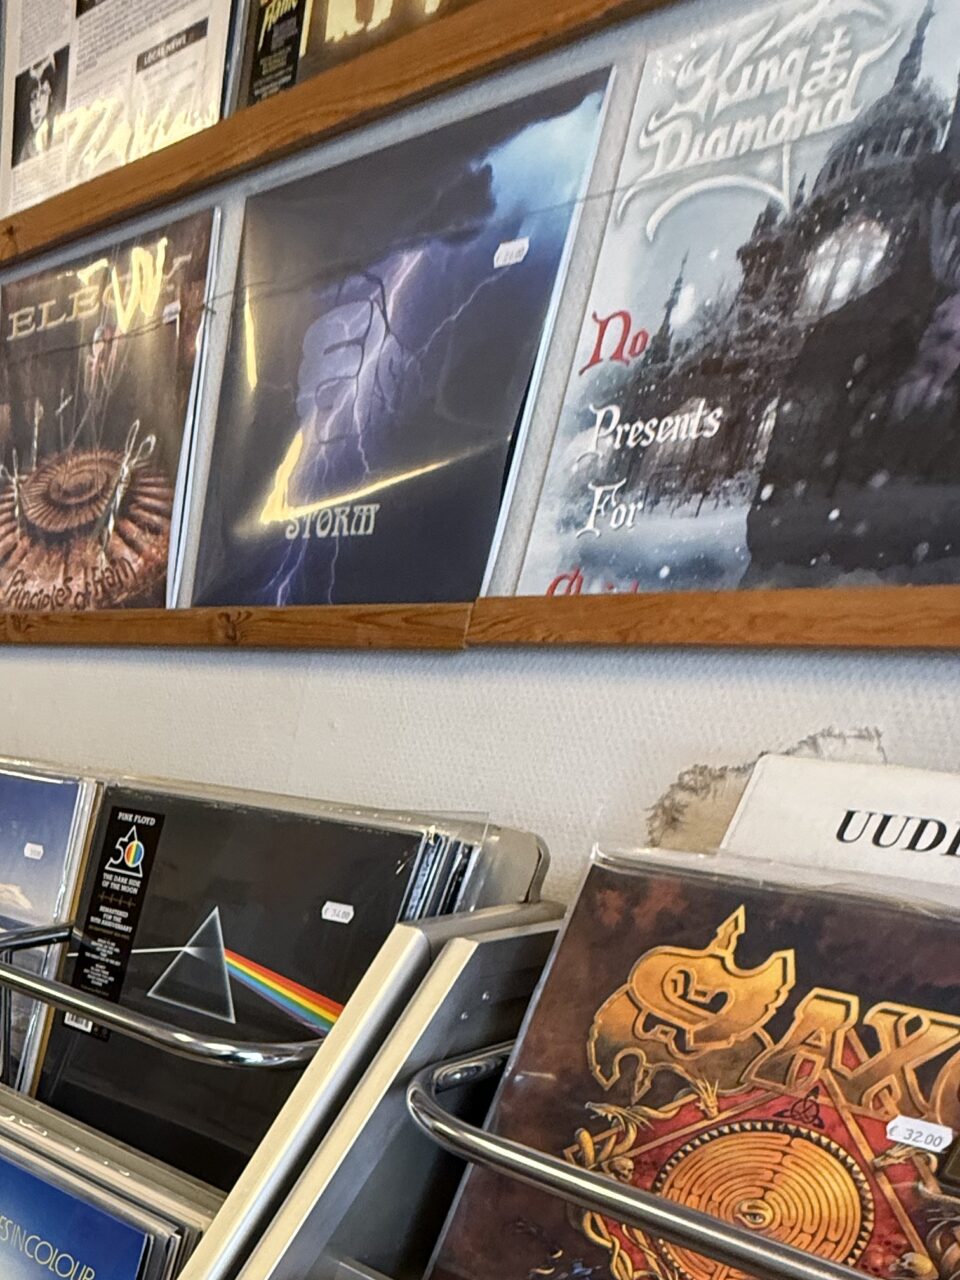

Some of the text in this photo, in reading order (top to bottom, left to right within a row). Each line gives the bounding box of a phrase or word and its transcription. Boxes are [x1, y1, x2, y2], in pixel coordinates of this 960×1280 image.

[645, 14, 812, 126] King
[638, 28, 900, 178] Diamond
[579, 311, 649, 375] No
[571, 397, 724, 472] Presents
[286, 503, 380, 539] STORM
[576, 477, 645, 540] For
[117, 811, 156, 827] PINK FLOYD
[835, 808, 960, 858] UUD
[585, 905, 960, 1110] SAX
[11, 1223, 28, 1251] IN
